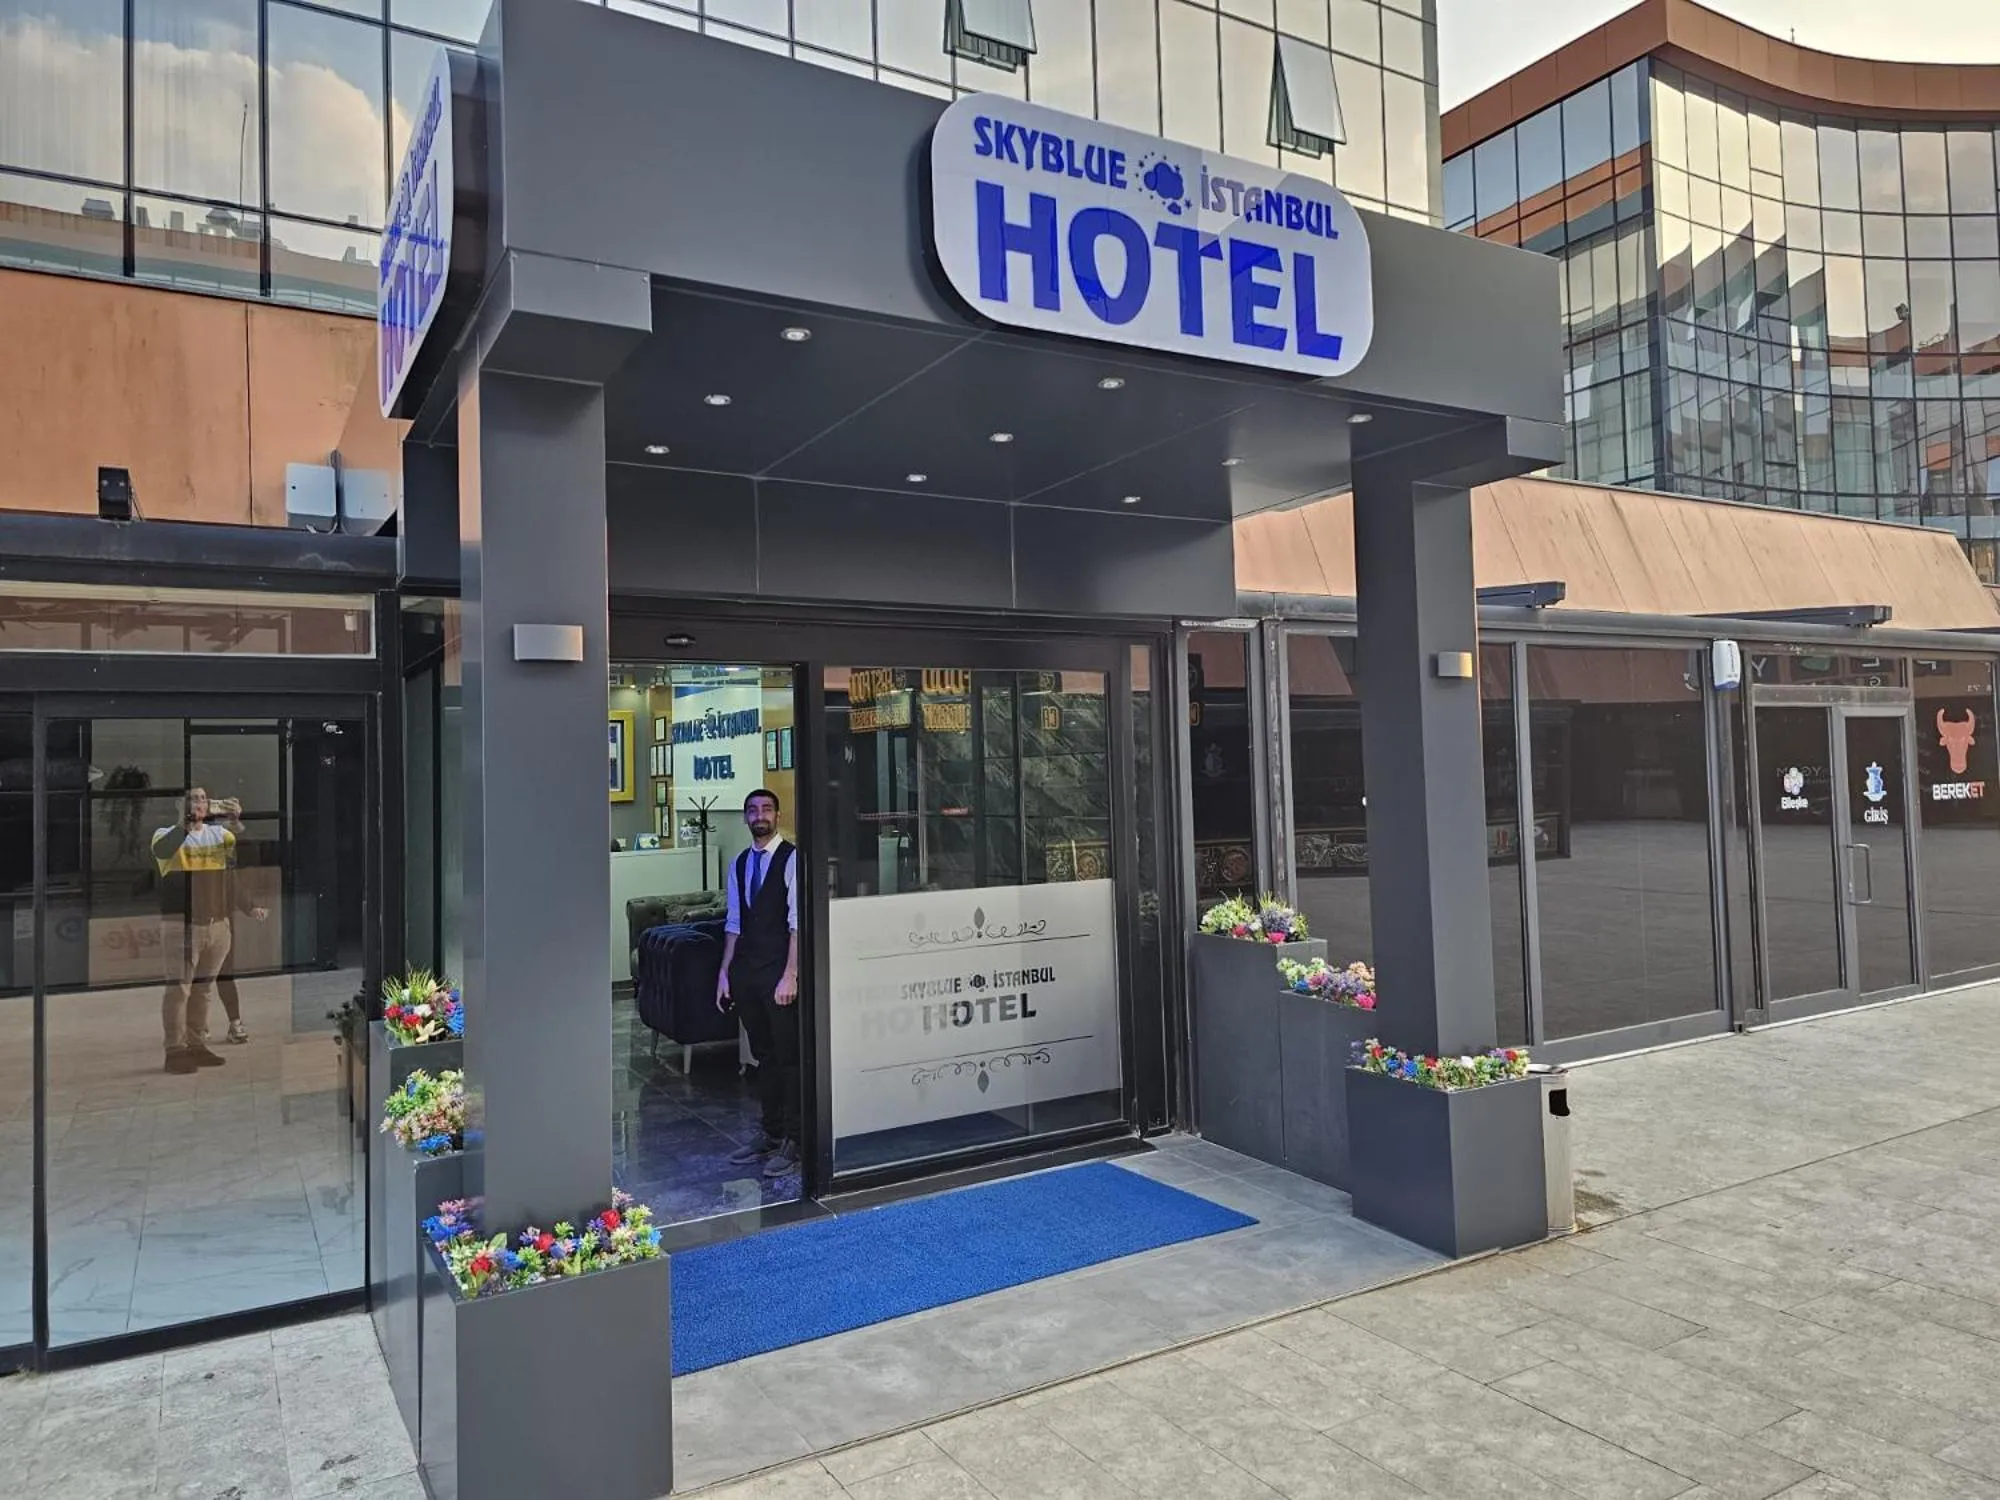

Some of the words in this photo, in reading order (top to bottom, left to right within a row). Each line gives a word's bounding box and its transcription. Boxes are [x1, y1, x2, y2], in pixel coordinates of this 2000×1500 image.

[974, 117, 1127, 189] SKYBLUE
[1201, 166, 1338, 240] İSTANBUL
[976, 180, 1343, 361] HOTEL
[693, 754, 735, 781] HOTEL
[1932, 781, 1985, 800] BEREKET
[901, 977, 962, 1000] SKYBLUE
[993, 966, 1056, 989] İSTANBUL
[922, 992, 1037, 1035] HOTEL
